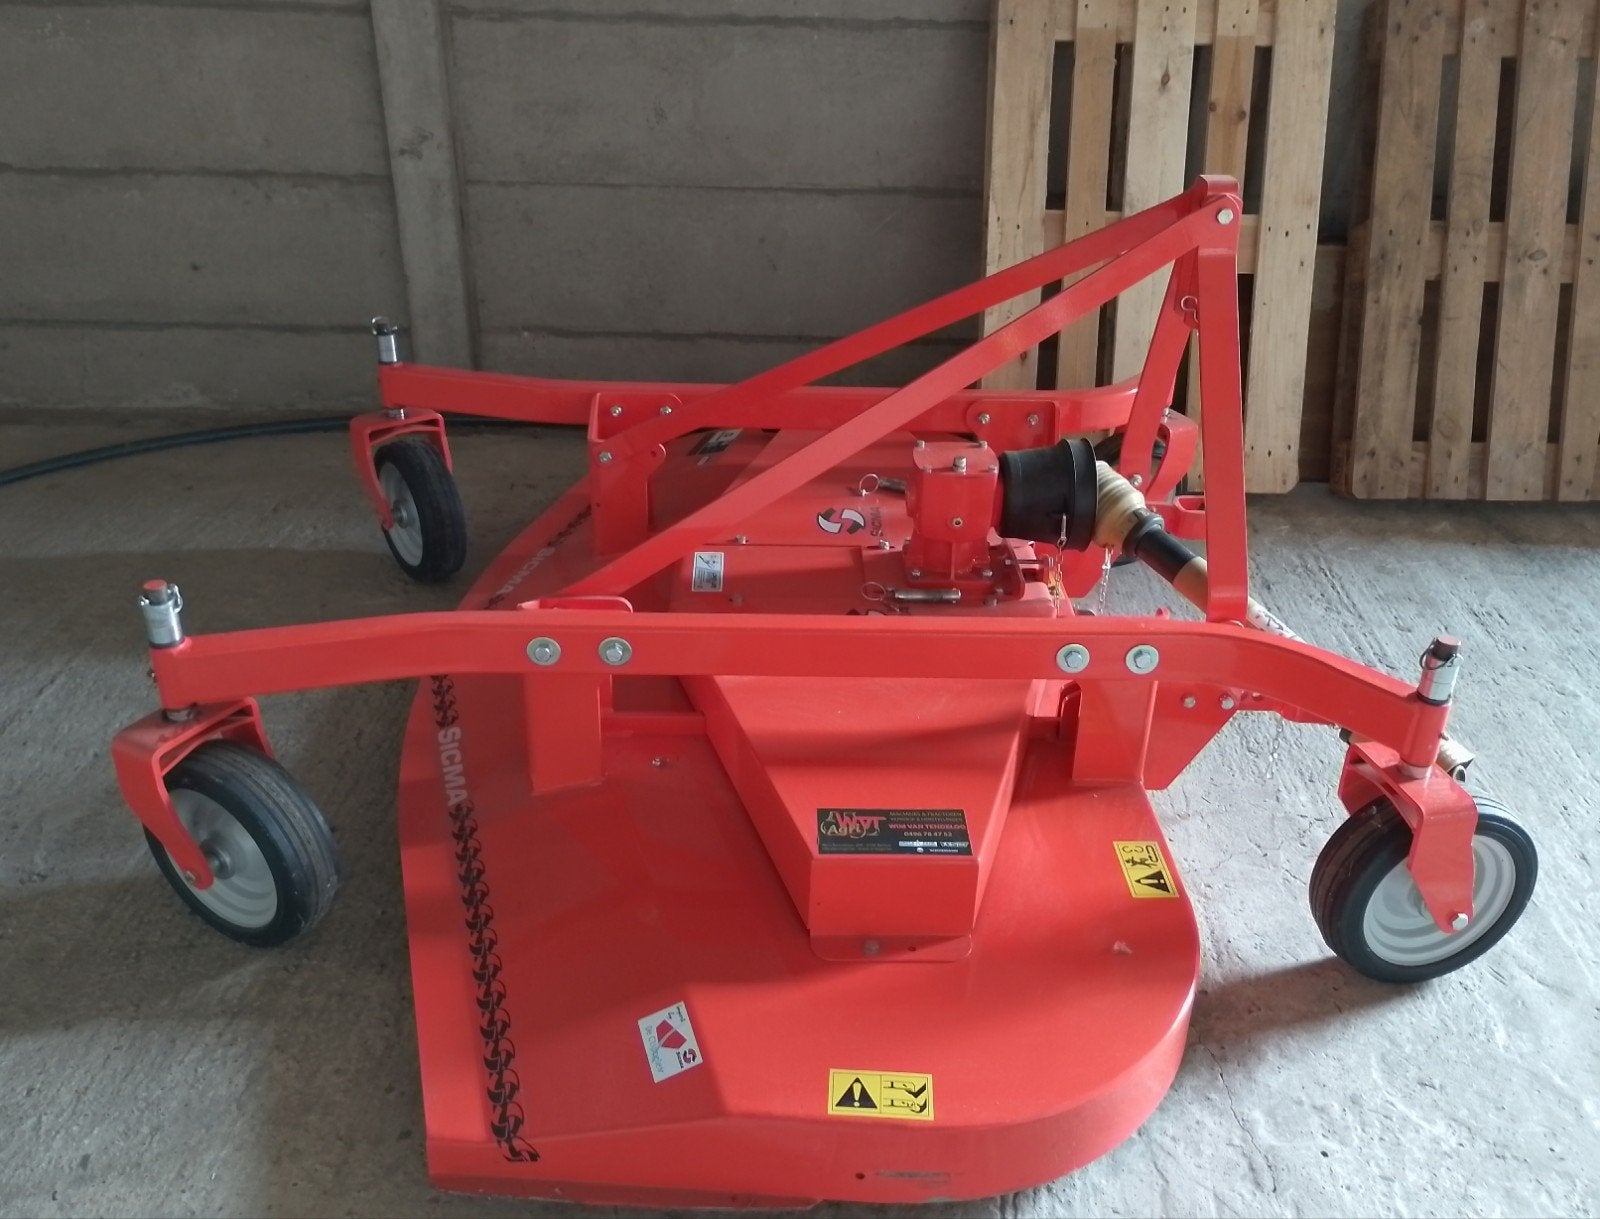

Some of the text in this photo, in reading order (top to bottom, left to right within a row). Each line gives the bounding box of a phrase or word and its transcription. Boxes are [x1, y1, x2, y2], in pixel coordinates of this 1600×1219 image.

[870, 506, 883, 537] SICMA
[495, 547, 556, 595] SICMA
[438, 726, 468, 806] SICMA
[826, 824, 861, 837] Agri
